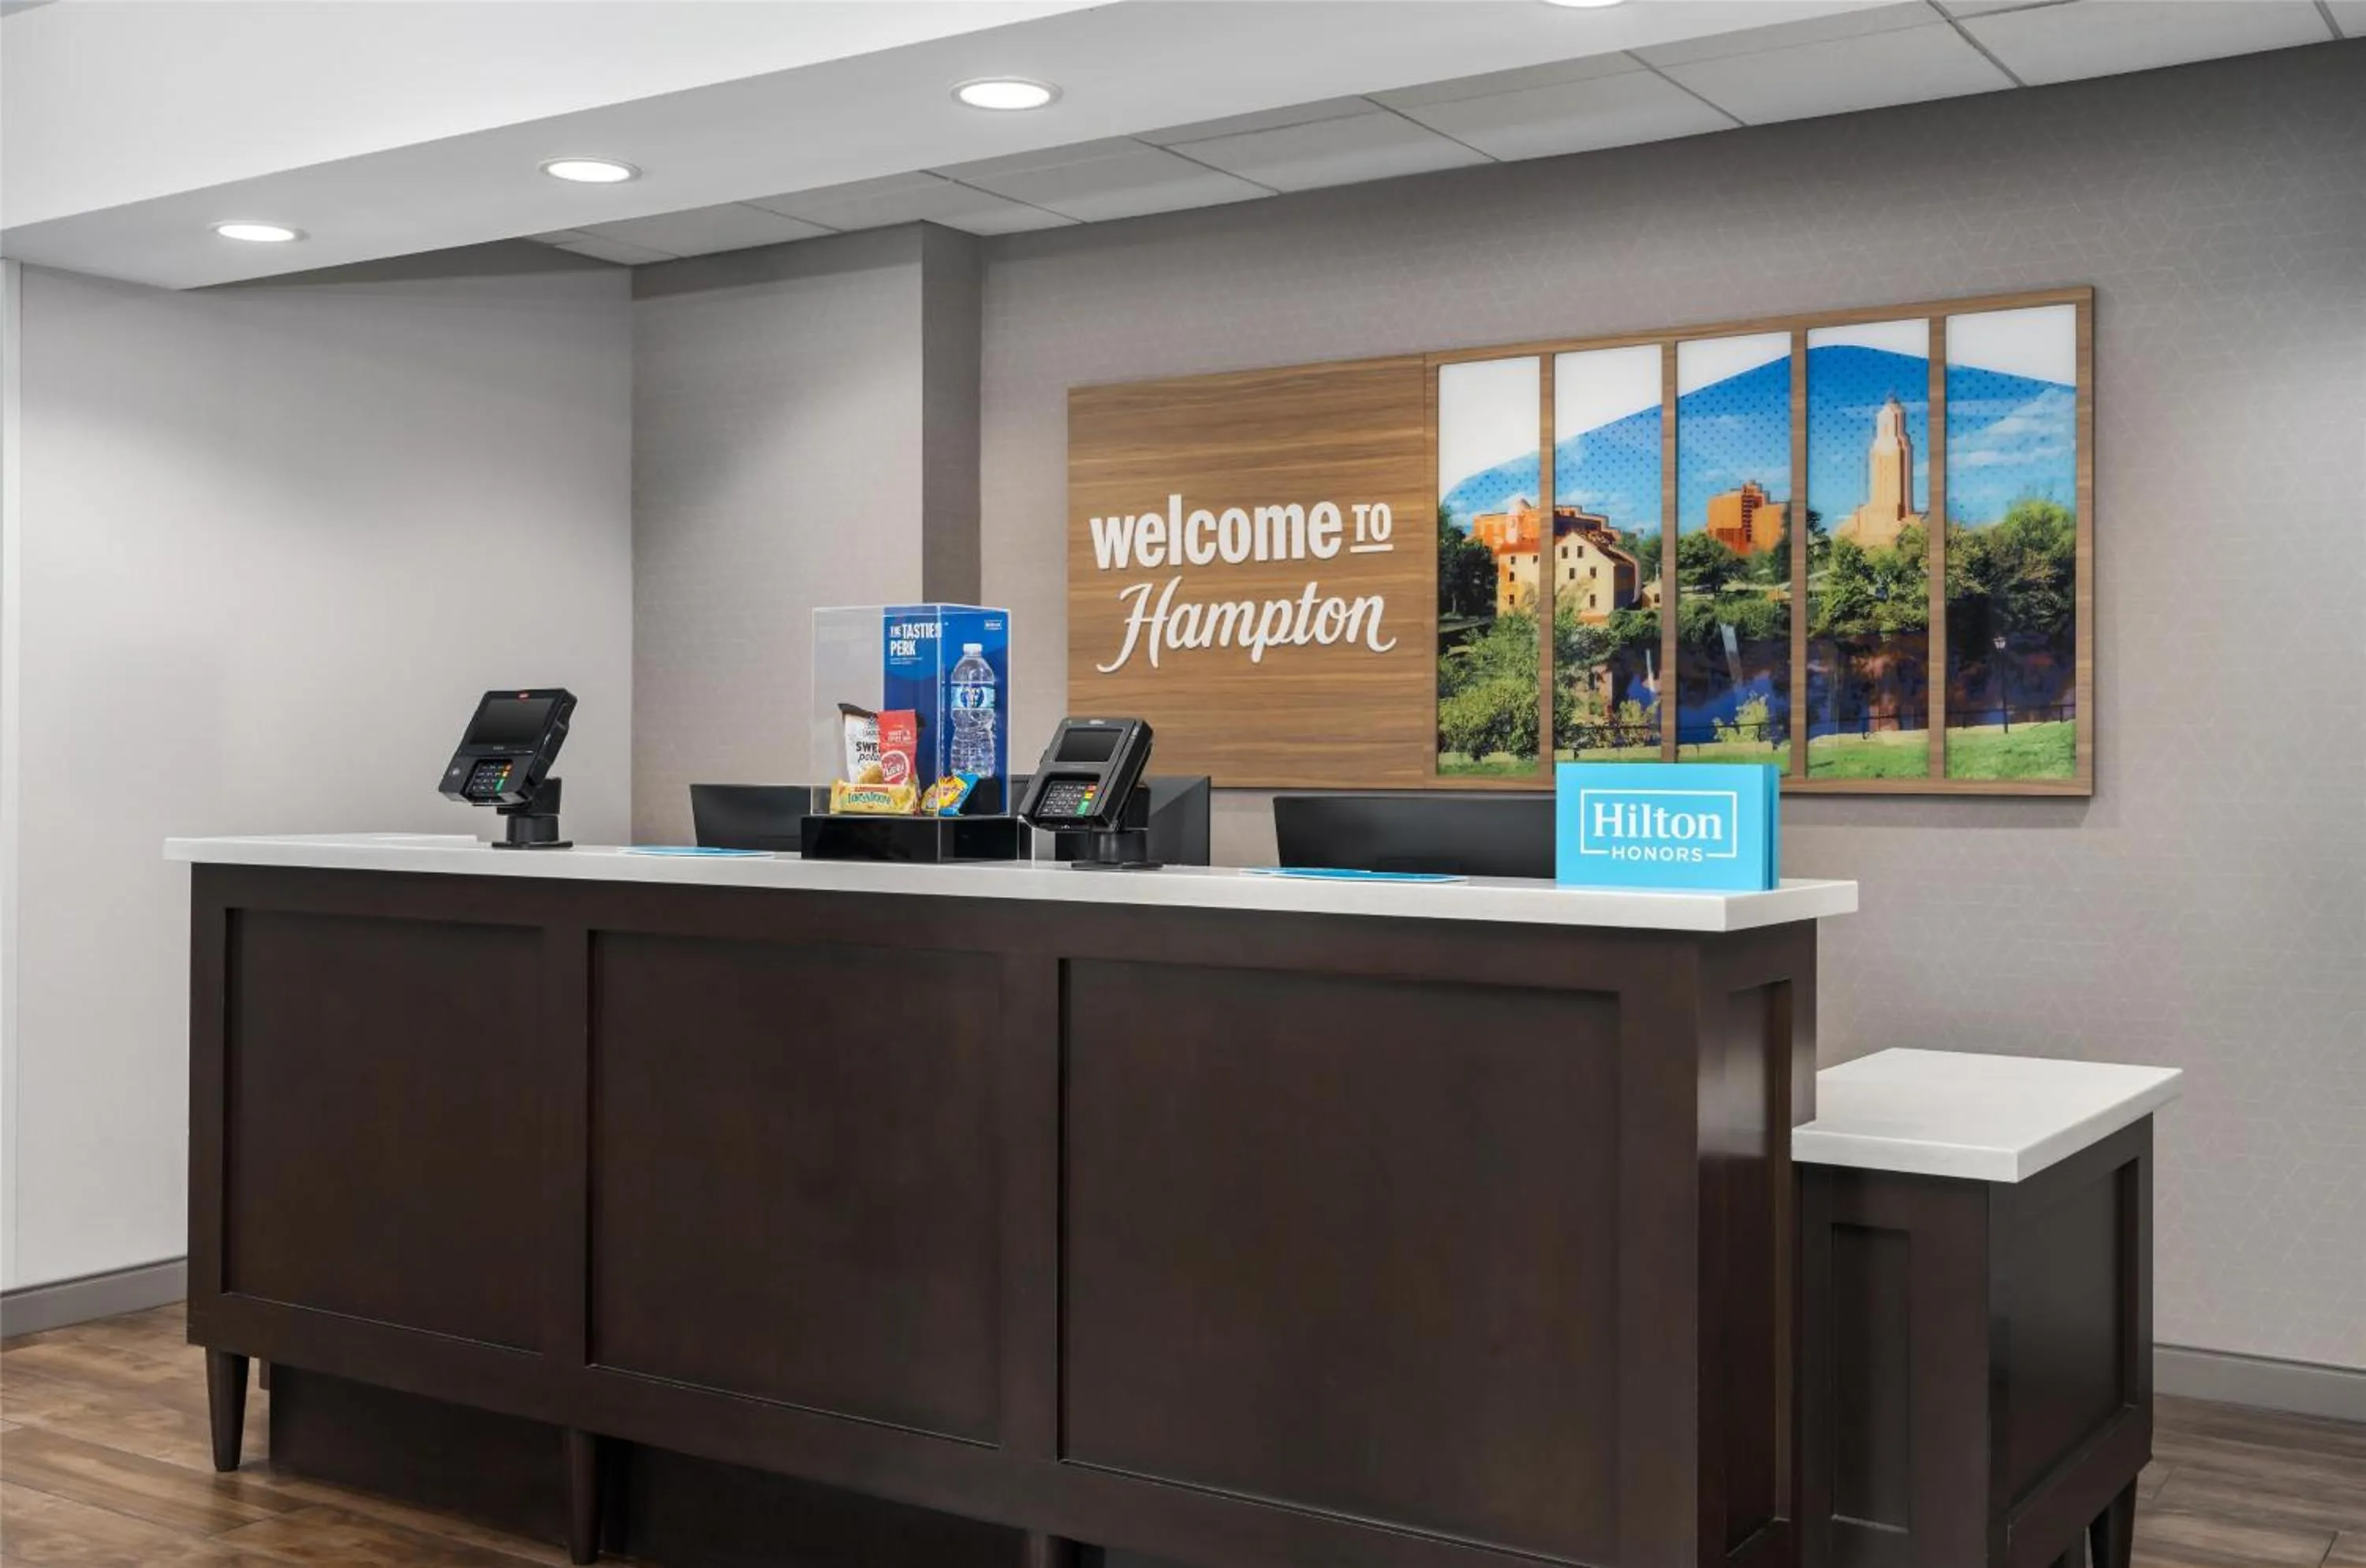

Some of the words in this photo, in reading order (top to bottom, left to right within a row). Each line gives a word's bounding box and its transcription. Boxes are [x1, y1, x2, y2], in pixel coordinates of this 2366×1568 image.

[1090, 494, 1342, 569] welcome
[1350, 502, 1393, 543] TO
[1096, 576, 1397, 674] Hampton
[890, 640, 916, 657] PERK
[1593, 802, 1723, 841] Hilton
[1611, 846, 1704, 863] HONORS
